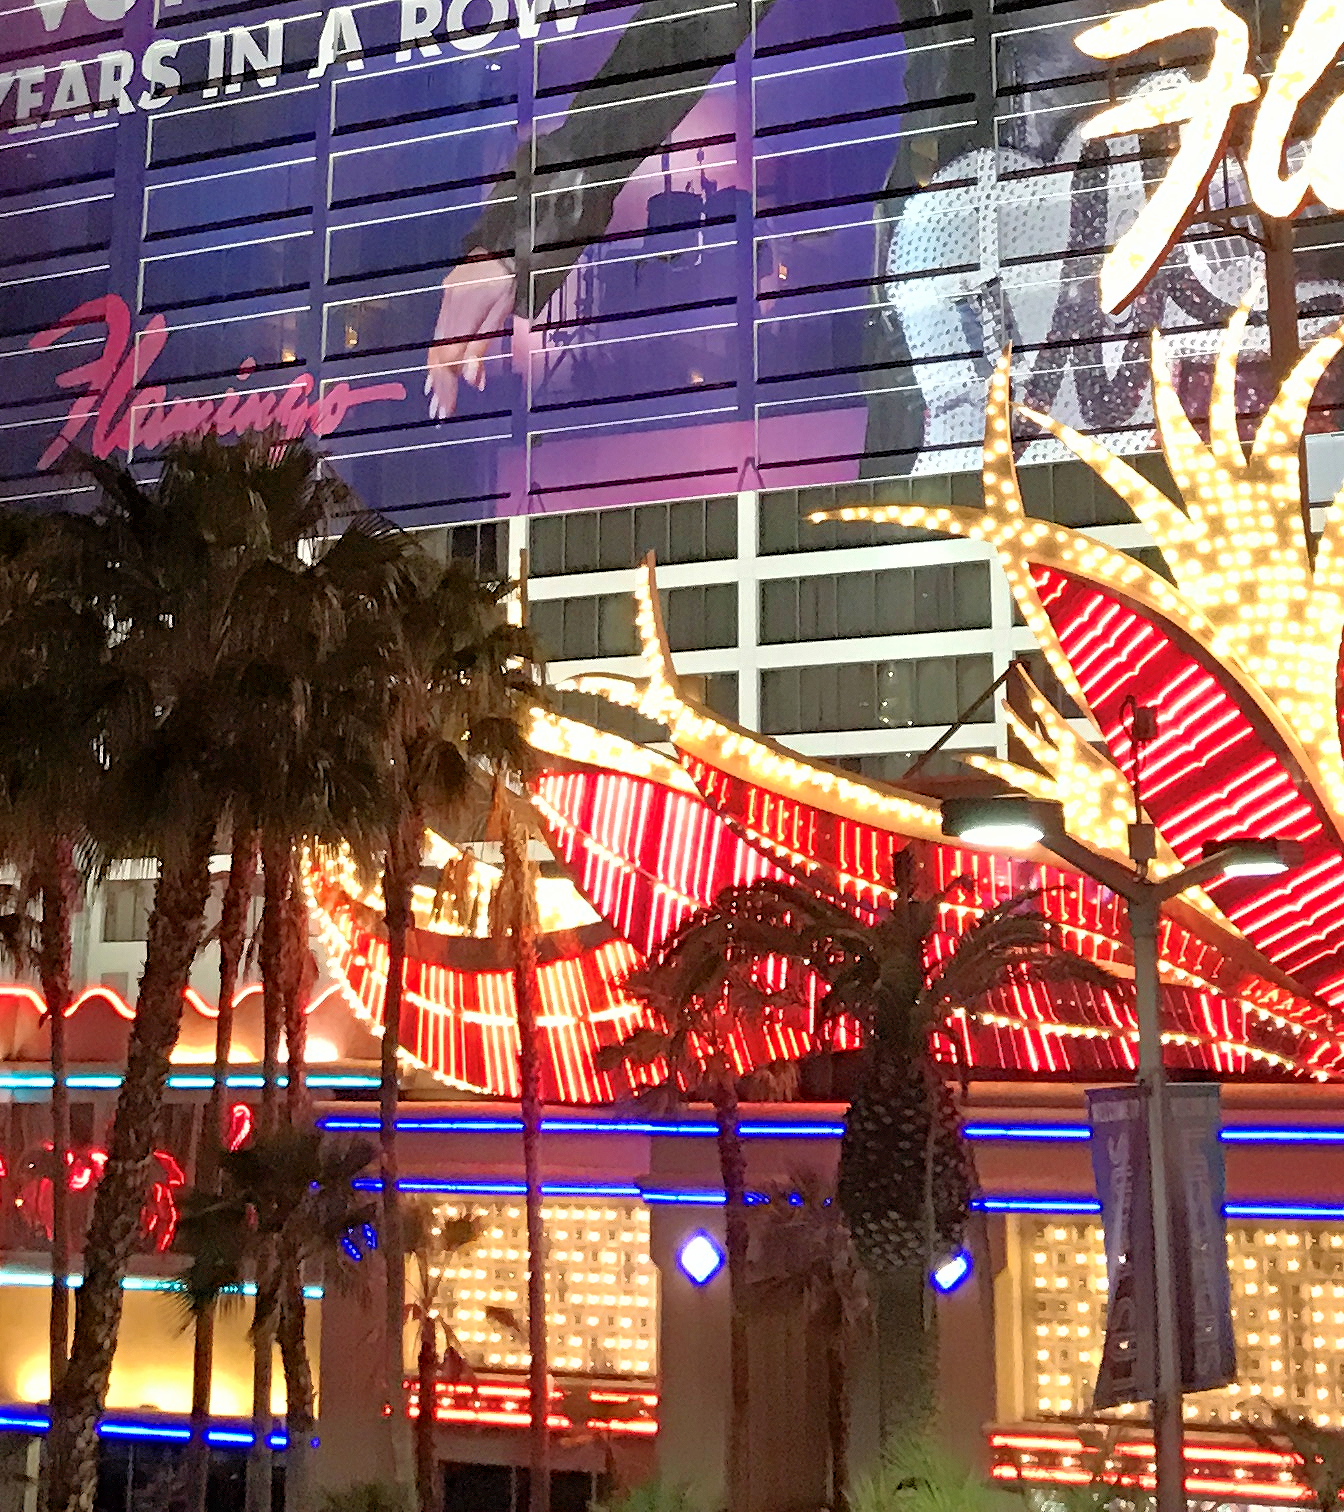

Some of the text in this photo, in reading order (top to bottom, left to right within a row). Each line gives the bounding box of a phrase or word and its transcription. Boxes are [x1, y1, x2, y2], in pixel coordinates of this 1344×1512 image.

[201, 18, 285, 98] IN
[308, 5, 365, 77] A
[28, 293, 406, 470] Flamingo
